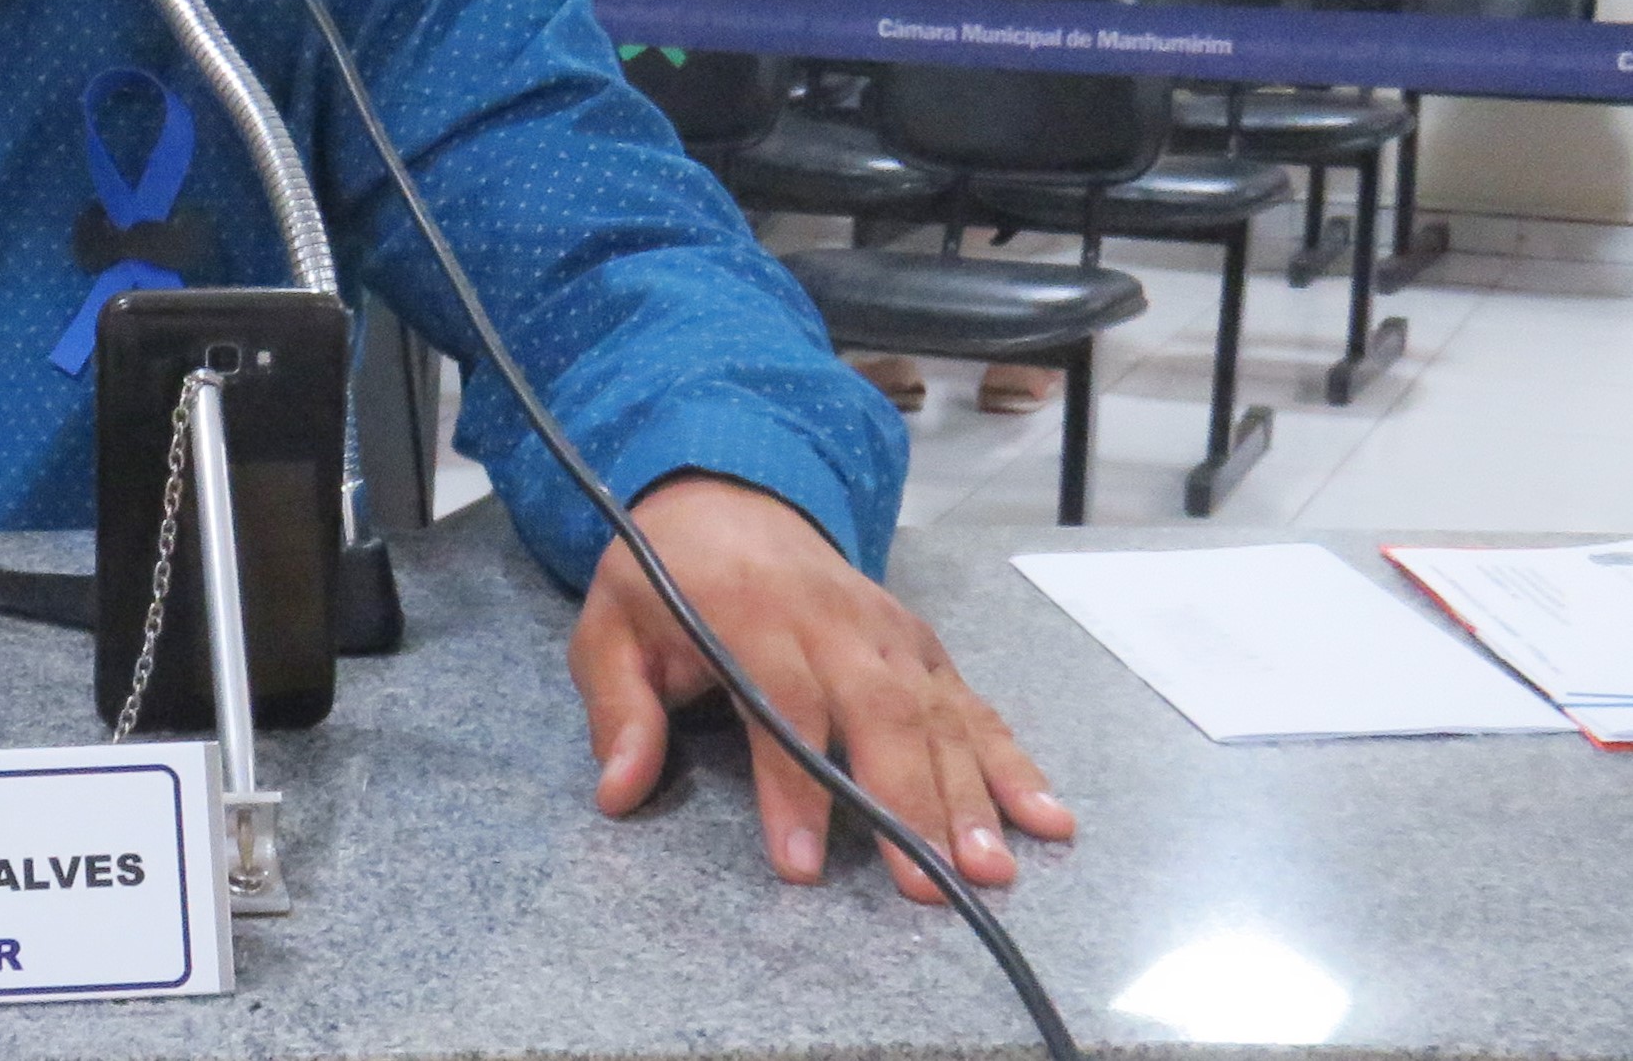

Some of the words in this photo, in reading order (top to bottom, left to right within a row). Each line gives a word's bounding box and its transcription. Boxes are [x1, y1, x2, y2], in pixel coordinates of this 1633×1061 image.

[961, 22, 1063, 50] Municipal
[1067, 28, 1092, 48] de
[1097, 29, 1233, 55] Manhumirim
